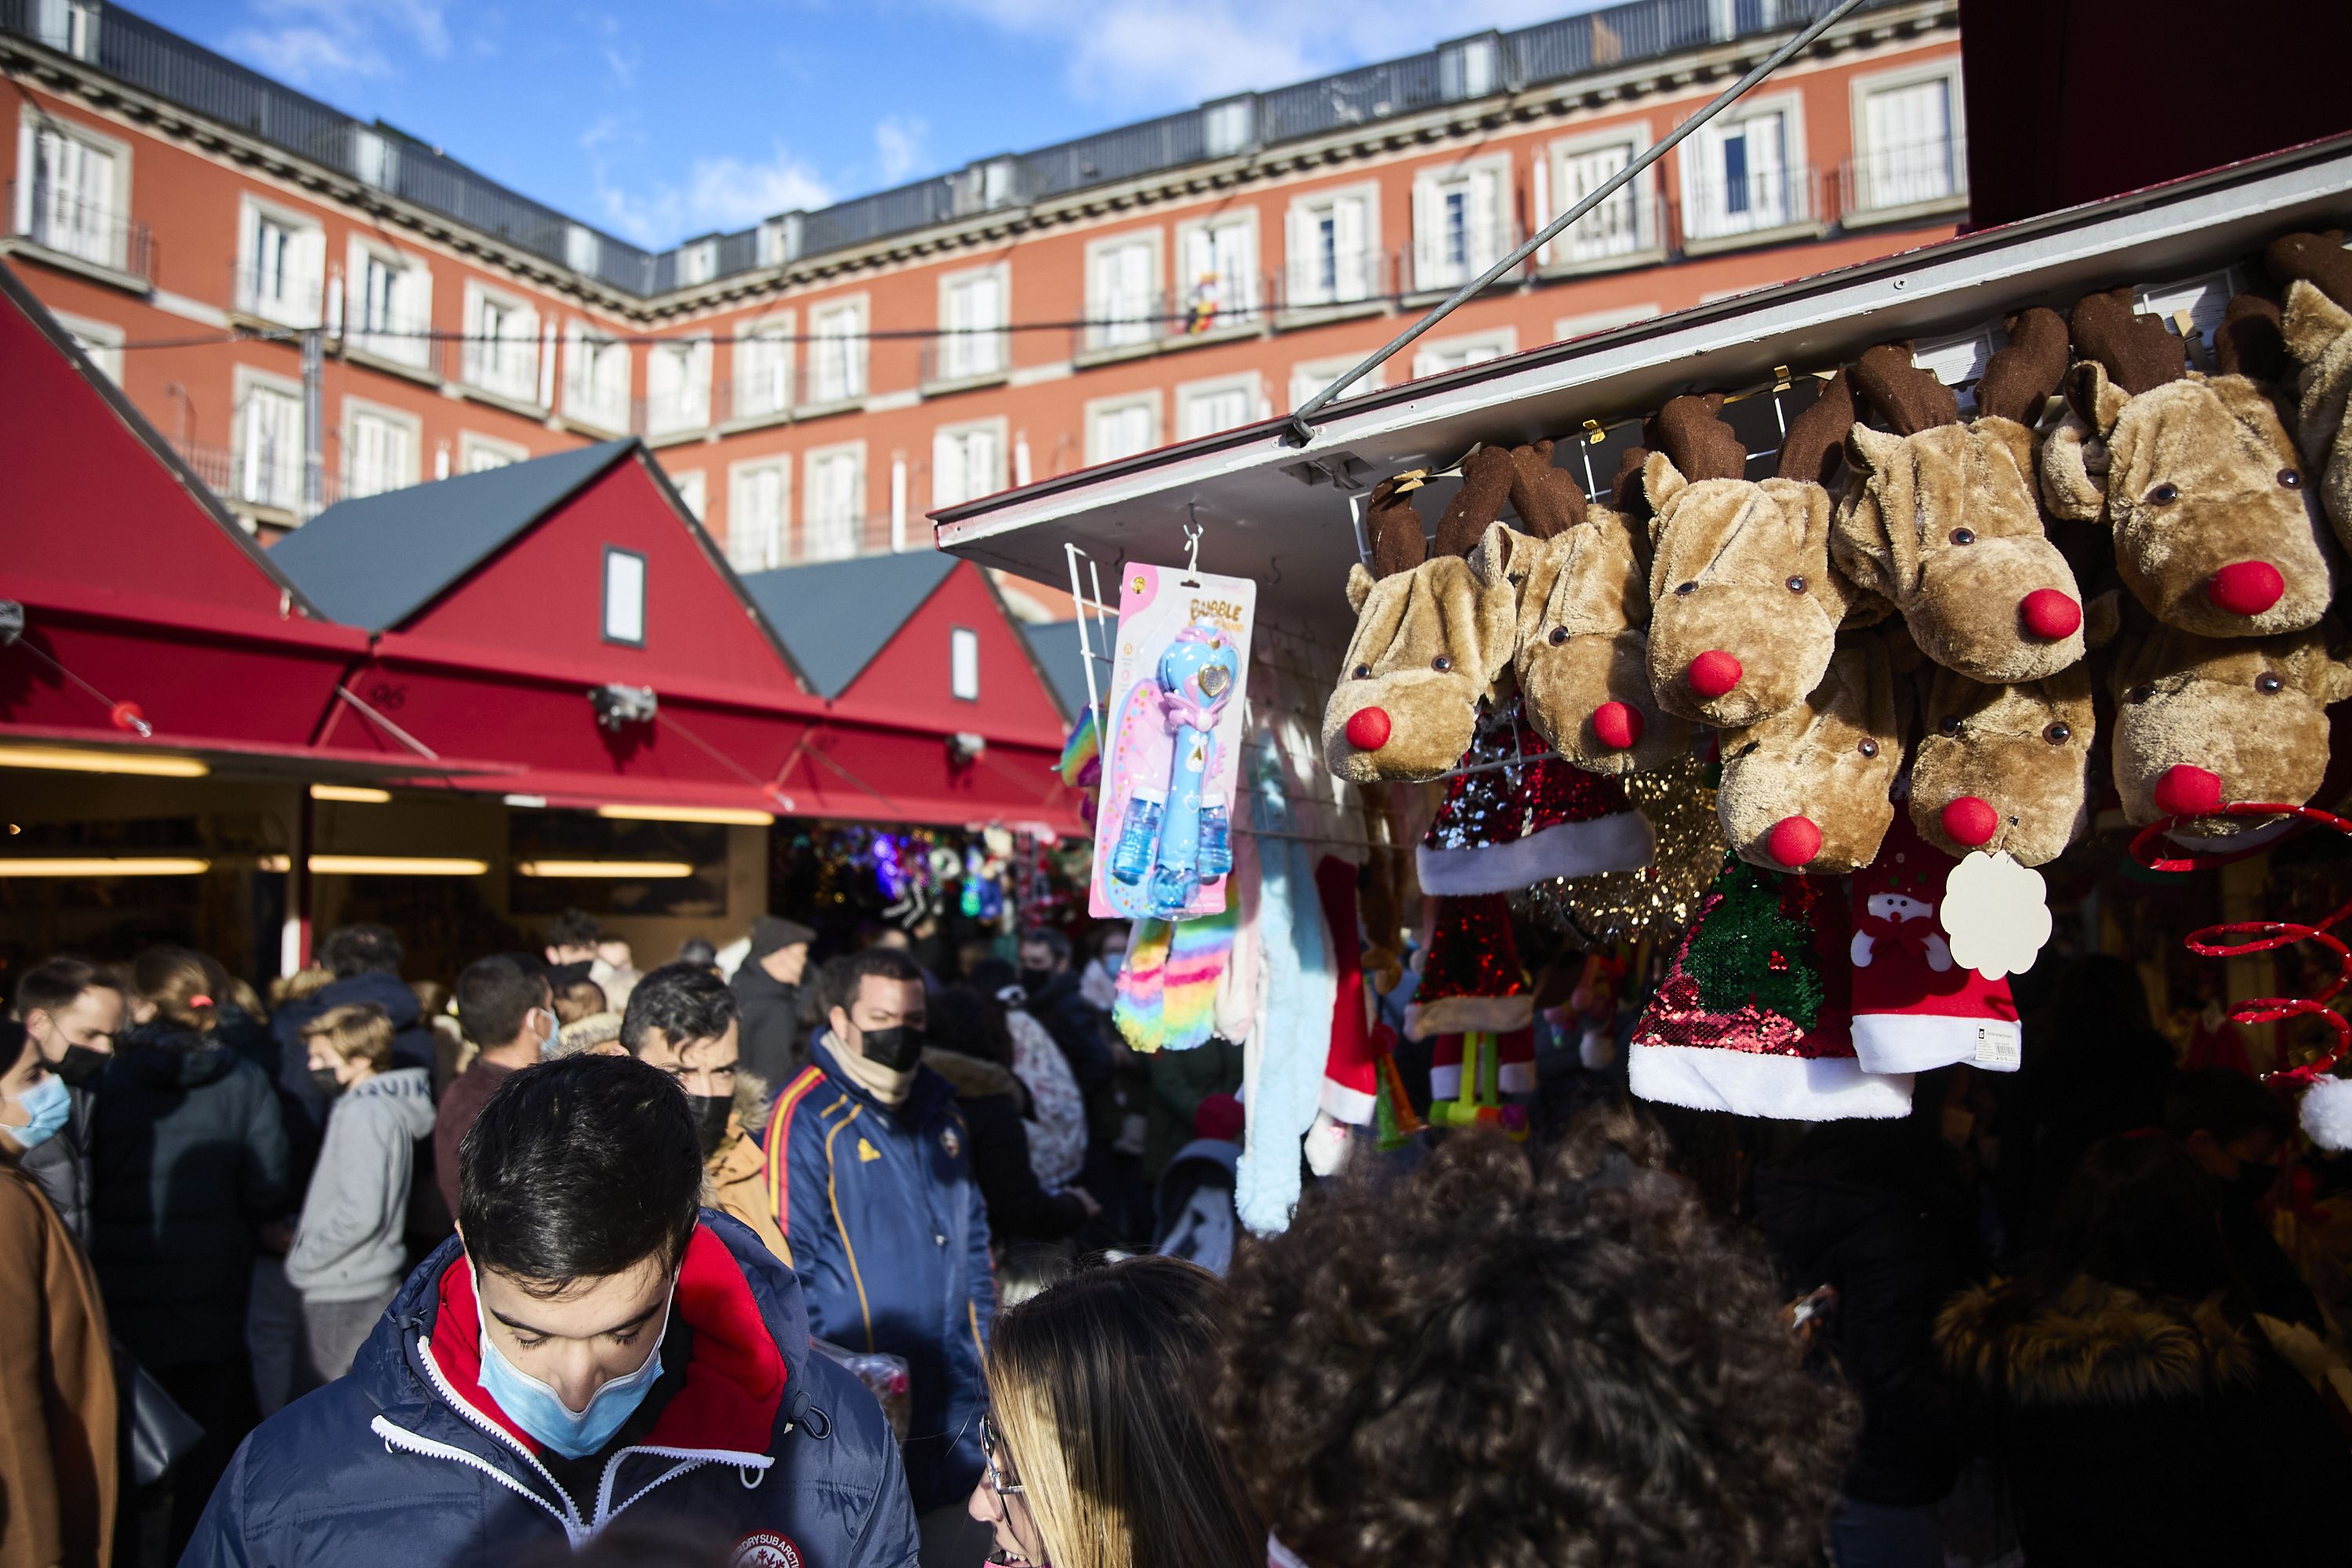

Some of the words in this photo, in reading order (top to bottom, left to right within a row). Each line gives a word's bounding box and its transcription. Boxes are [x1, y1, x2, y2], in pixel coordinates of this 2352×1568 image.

[1191, 598, 1243, 621] BUBBLE
[760, 1534, 779, 1546] SUB
[778, 1541, 800, 1568] ARCTI
